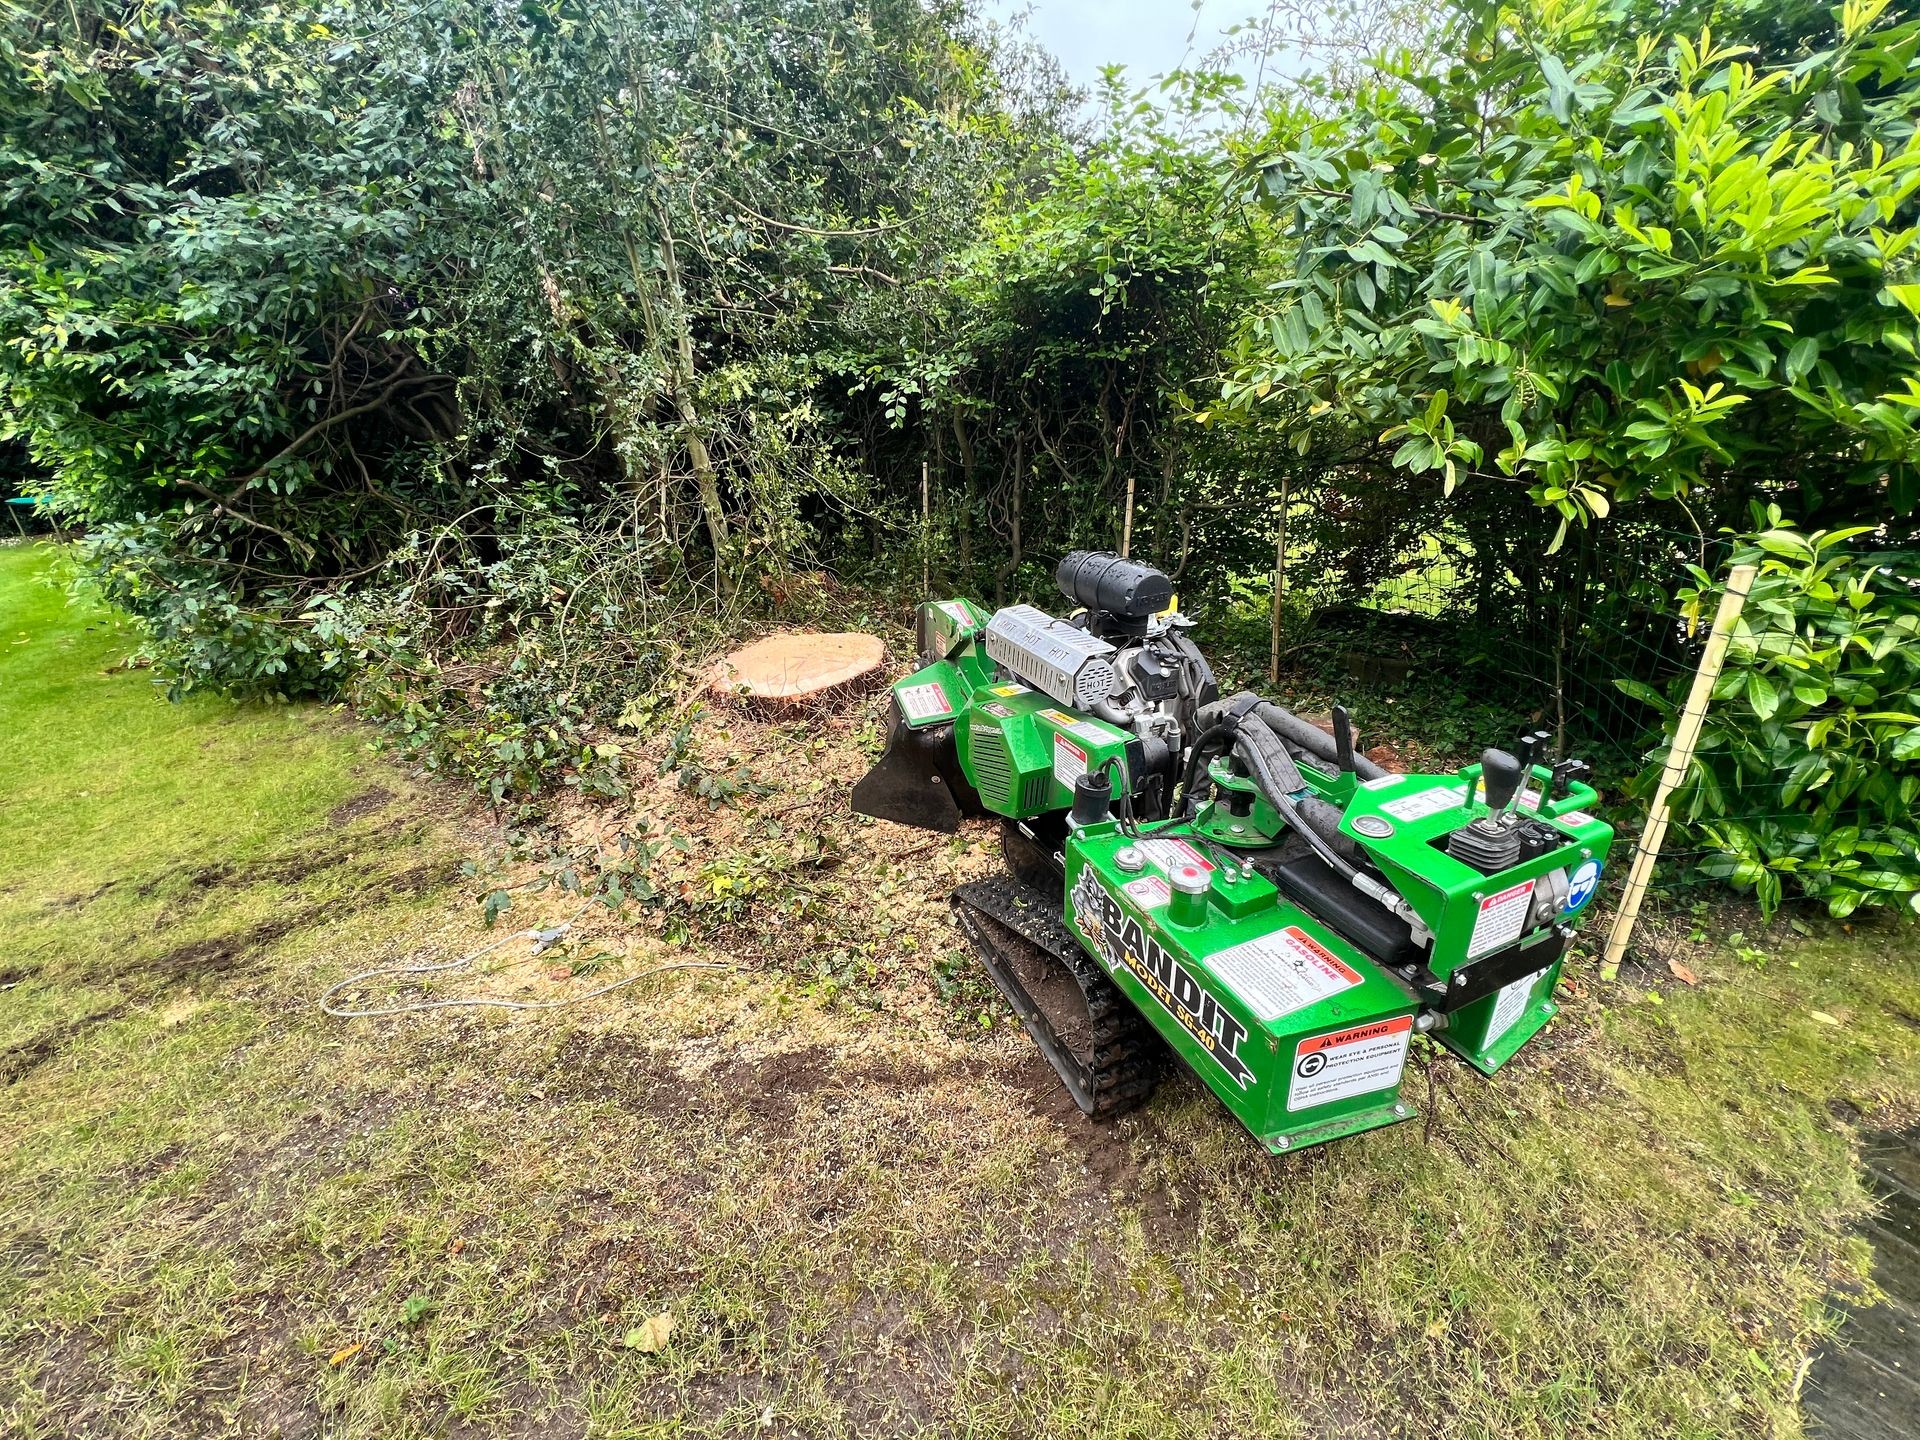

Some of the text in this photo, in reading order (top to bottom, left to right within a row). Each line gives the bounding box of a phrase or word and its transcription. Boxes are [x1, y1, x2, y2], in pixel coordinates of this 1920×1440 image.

[1024, 632, 1041, 646] HOT
[1049, 647, 1069, 661] HOT
[1086, 678, 1106, 690] HOT
[1496, 886, 1526, 903] DANGER
[1284, 938, 1340, 981] GASOLINE
[1307, 943, 1346, 974] WARNING
[1102, 894, 1248, 1057] BANDIT
[1124, 949, 1173, 1008] MODEL
[1175, 1004, 1215, 1051] SG-40
[1335, 1025, 1389, 1043] WARNING
[1325, 1048, 1401, 1069] PROTECTION EQUIPMENT
[1329, 1052, 1347, 1061] WEAR
[1368, 1042, 1400, 1052] PERSONAL
